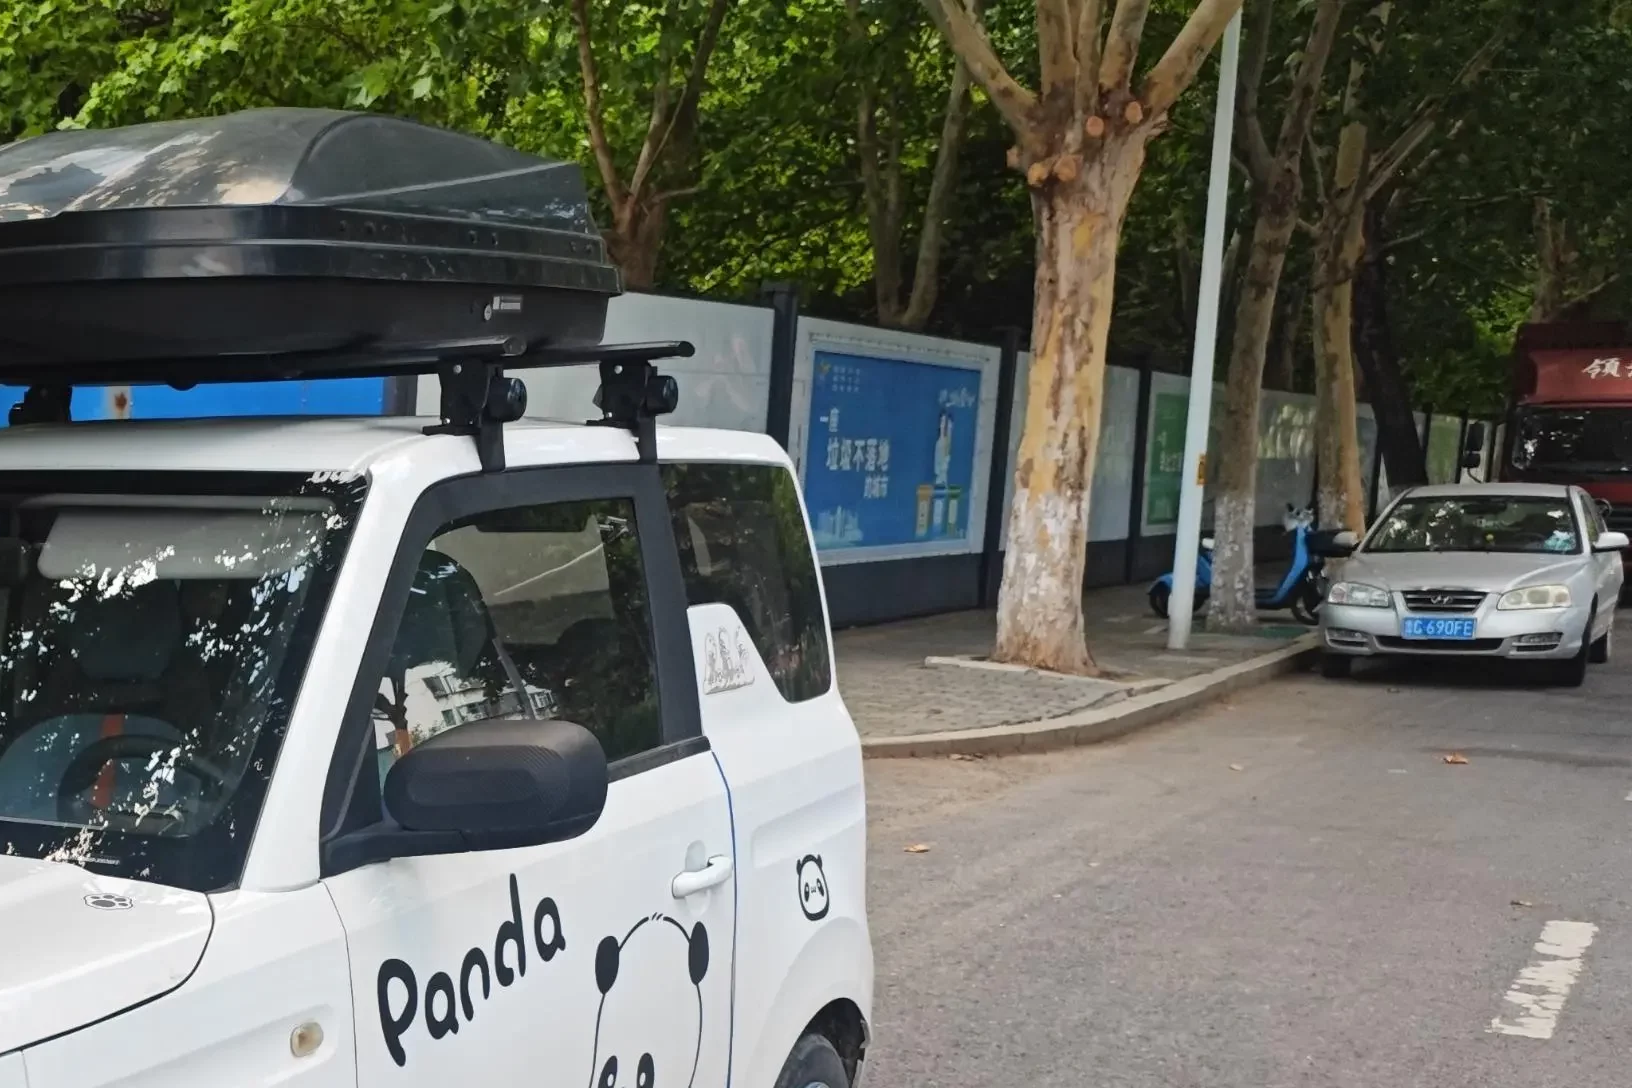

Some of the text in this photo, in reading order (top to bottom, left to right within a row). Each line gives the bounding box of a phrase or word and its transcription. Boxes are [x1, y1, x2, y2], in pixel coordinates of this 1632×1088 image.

[826, 436, 889, 472] 垃圾不落地
[377, 873, 566, 1067] Panda
